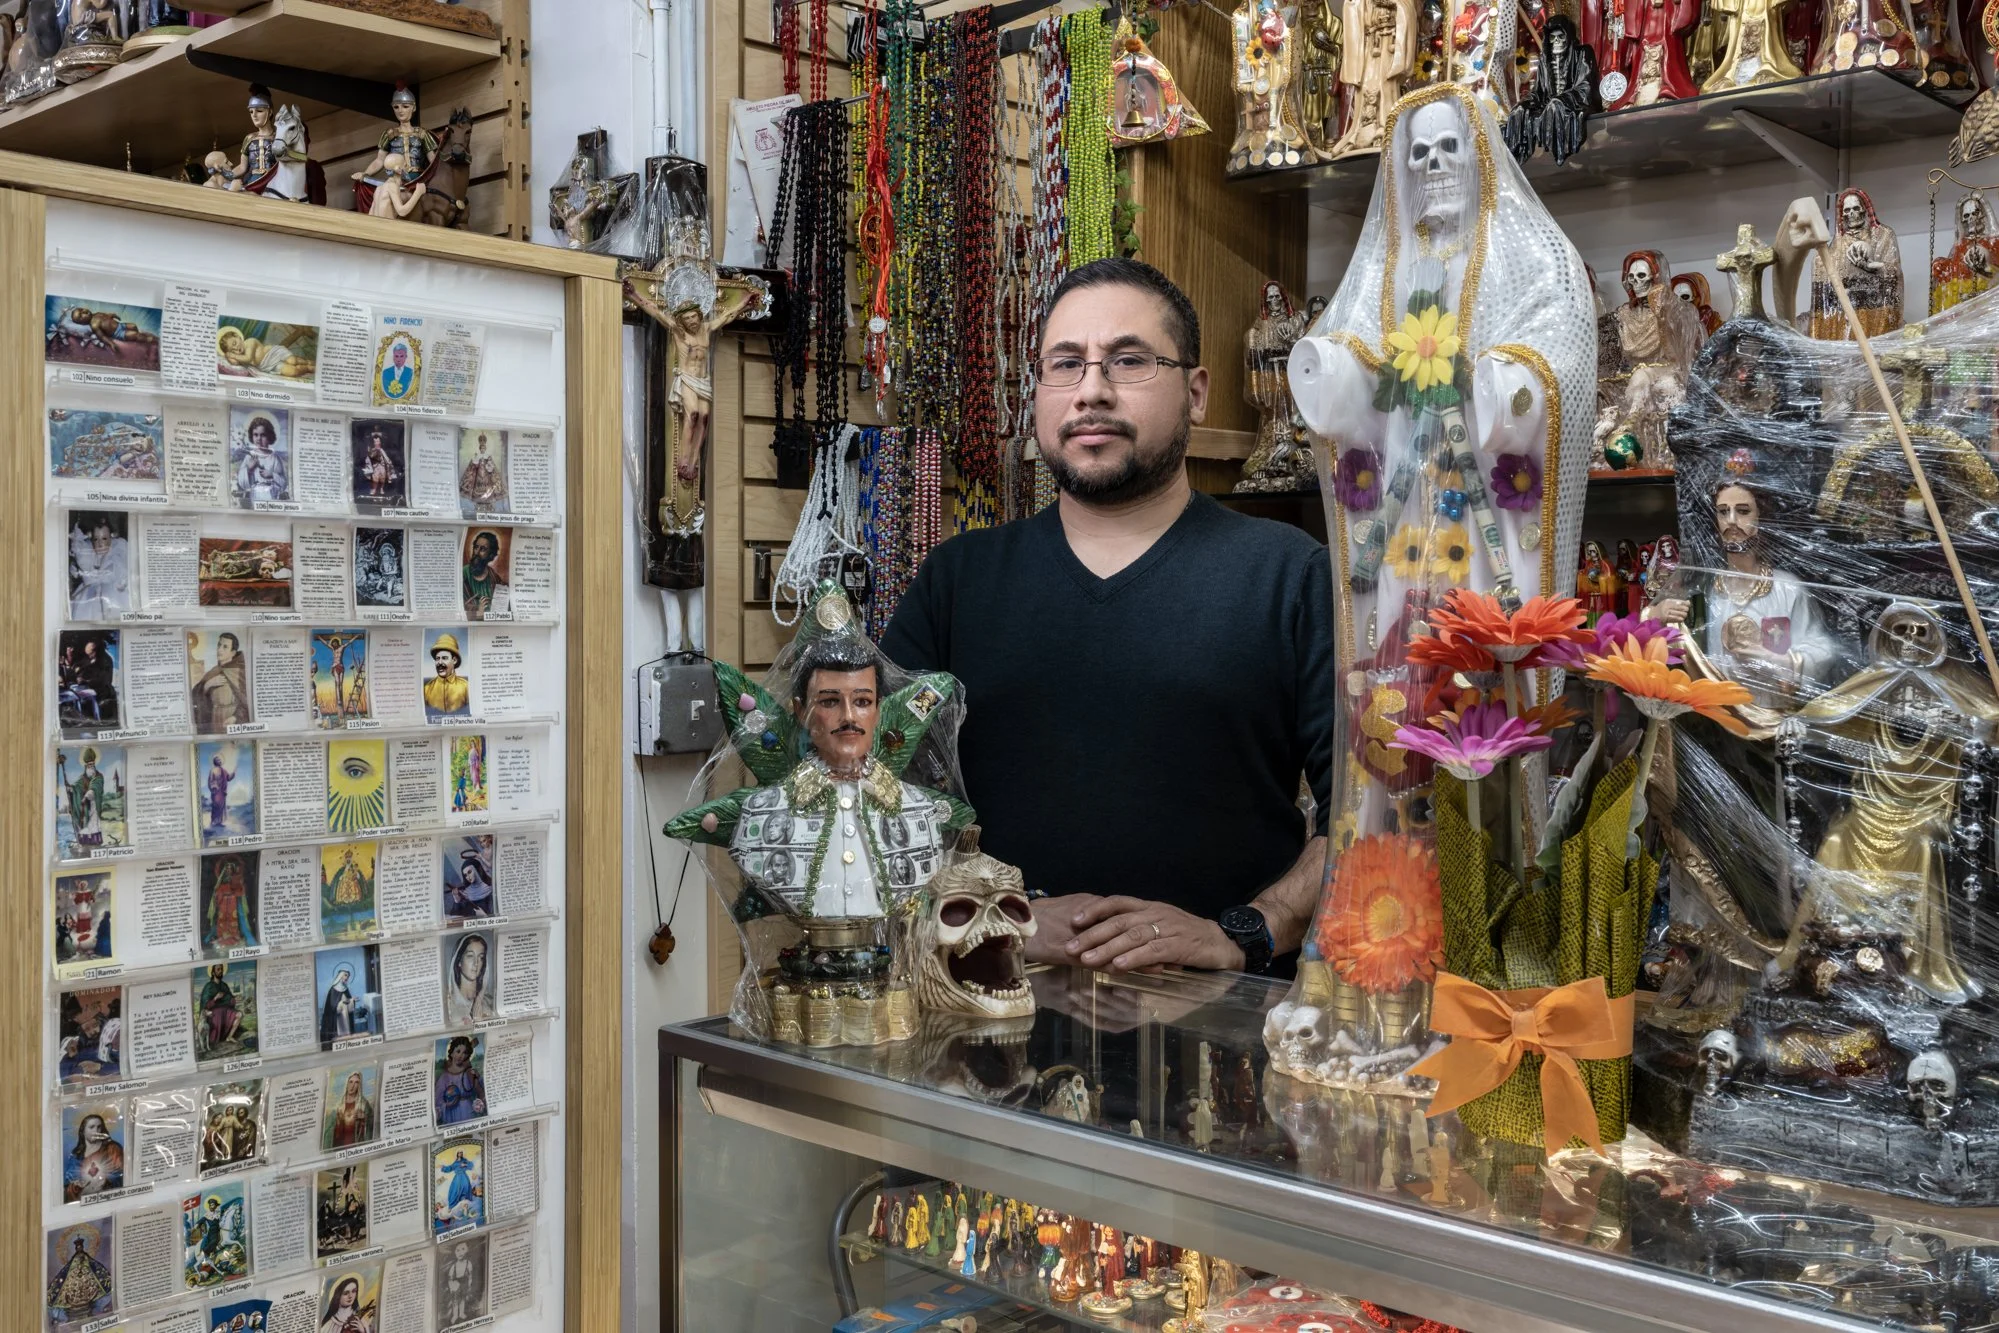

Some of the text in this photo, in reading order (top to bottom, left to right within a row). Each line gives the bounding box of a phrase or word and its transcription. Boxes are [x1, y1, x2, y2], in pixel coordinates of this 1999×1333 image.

[103, 376, 133, 384] consuelo
[264, 392, 290, 400] dormido
[408, 406, 421, 414] Nino
[284, 504, 299, 512] jesus
[243, 724, 265, 732] Pascual
[362, 720, 379, 728] Pasion
[115, 729, 148, 738] Pafnuncio
[363, 828, 378, 836] Poder
[380, 827, 404, 836] supremo
[244, 835, 262, 843] Pedro
[109, 848, 134, 856] Patricio
[245, 947, 260, 956] Rayo
[98, 967, 121, 976] Ramon
[348, 1040, 361, 1048] Rosa
[370, 1036, 382, 1044] lima
[226, 1059, 260, 1071] 126 Roque
[89, 1080, 146, 1094] 125 Rey Salomon
[457, 1124, 478, 1134] Salvador
[489, 1117, 508, 1126] Mundo
[348, 1147, 363, 1157] Dulce
[364, 1143, 386, 1153] corazon
[395, 1136, 411, 1145] Maria
[218, 1164, 242, 1176] Sagrada
[244, 1158, 266, 1168] Familia
[84, 1185, 153, 1203] 129 Sagrado corazon
[451, 1226, 475, 1238] Sebastian
[342, 1253, 360, 1263] Santos
[362, 1248, 383, 1258] varones
[225, 1282, 251, 1294] Santiago
[283, 1290, 306, 1300] ORACION
[85, 1317, 118, 1333] 133 Salud
[474, 1316, 493, 1326] Herrera
